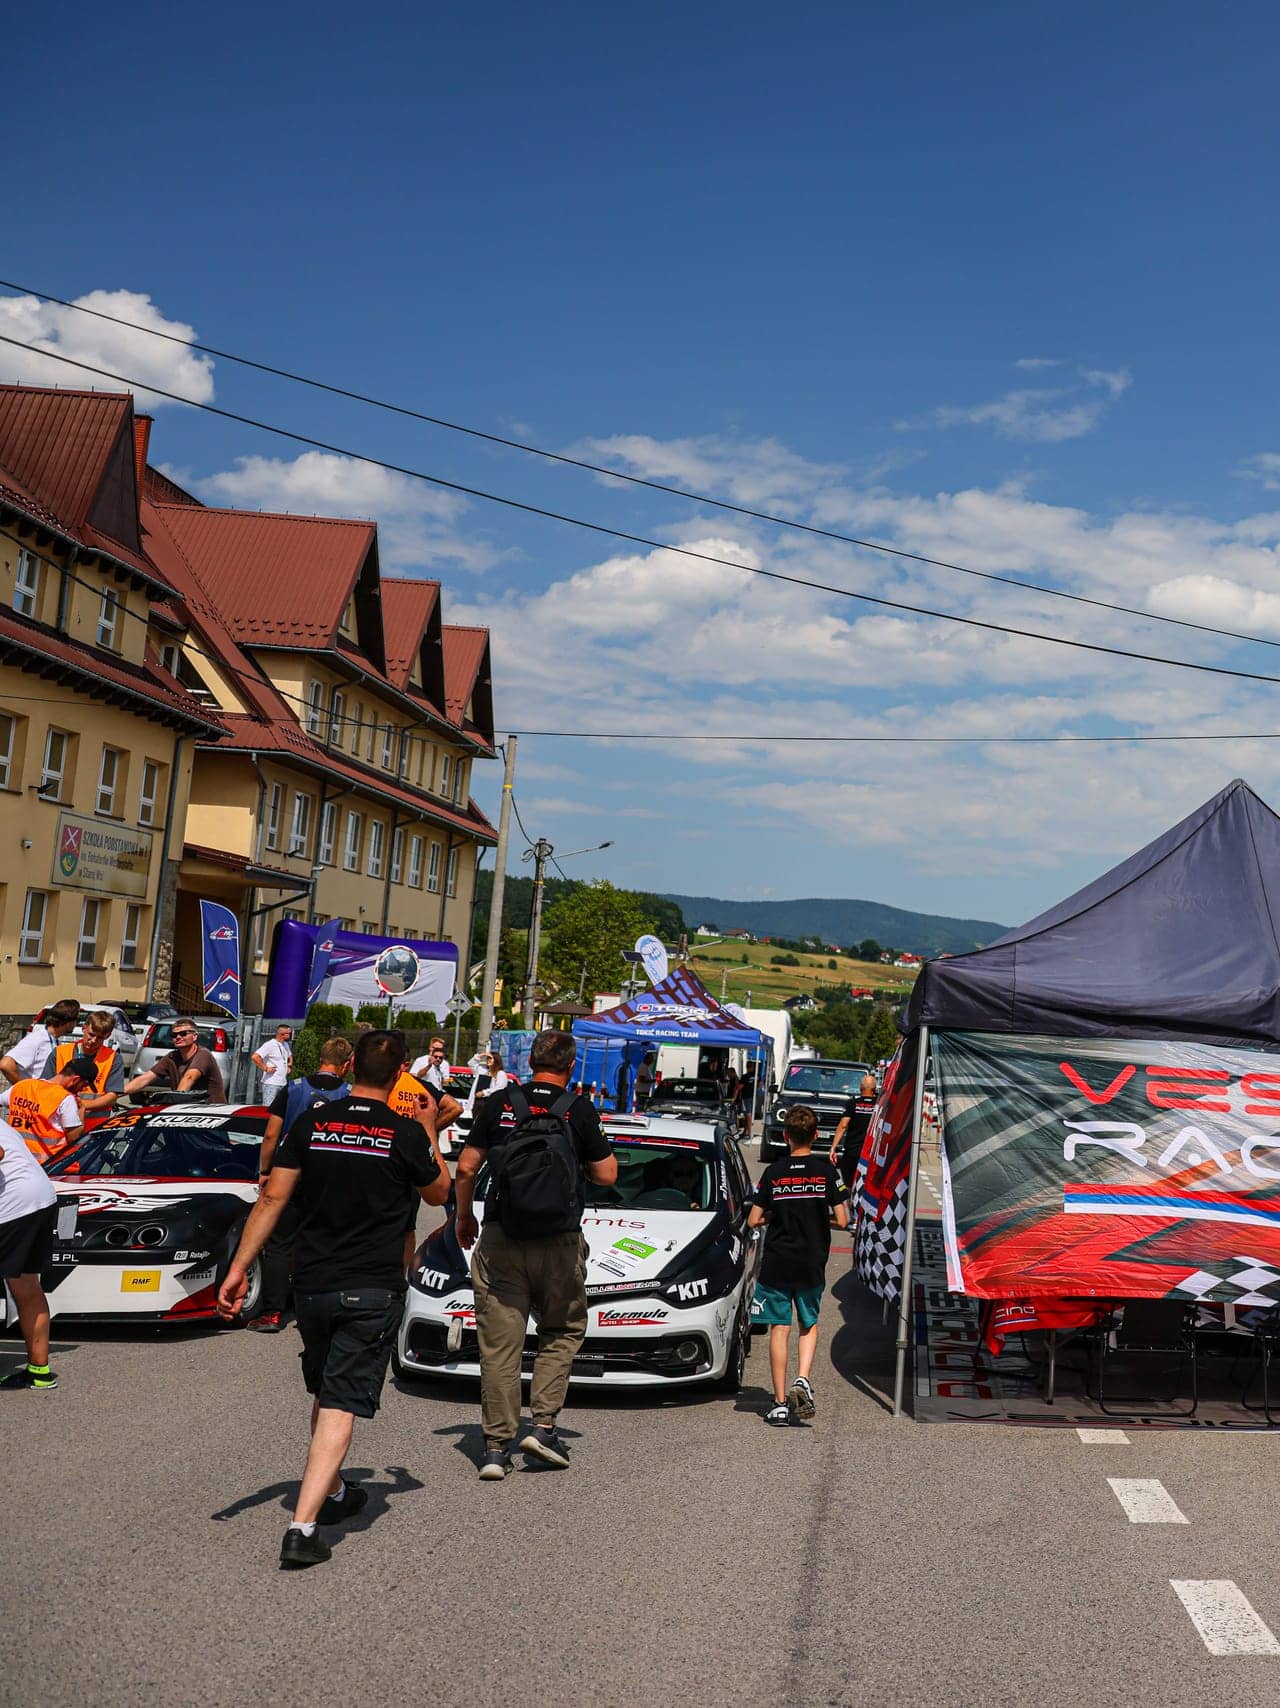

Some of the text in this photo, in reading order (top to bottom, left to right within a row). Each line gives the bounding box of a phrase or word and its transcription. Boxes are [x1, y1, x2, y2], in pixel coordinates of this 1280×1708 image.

[680, 1031, 699, 1039] TEAM
[103, 1115, 141, 1128] 53
[314, 1121, 395, 1138] VESNIC
[310, 1132, 393, 1149] RACING
[771, 1176, 827, 1186] VESNIC
[771, 1185, 827, 1194] RACING
[131, 1278, 152, 1286] RMF
[603, 1309, 669, 1320] formula
